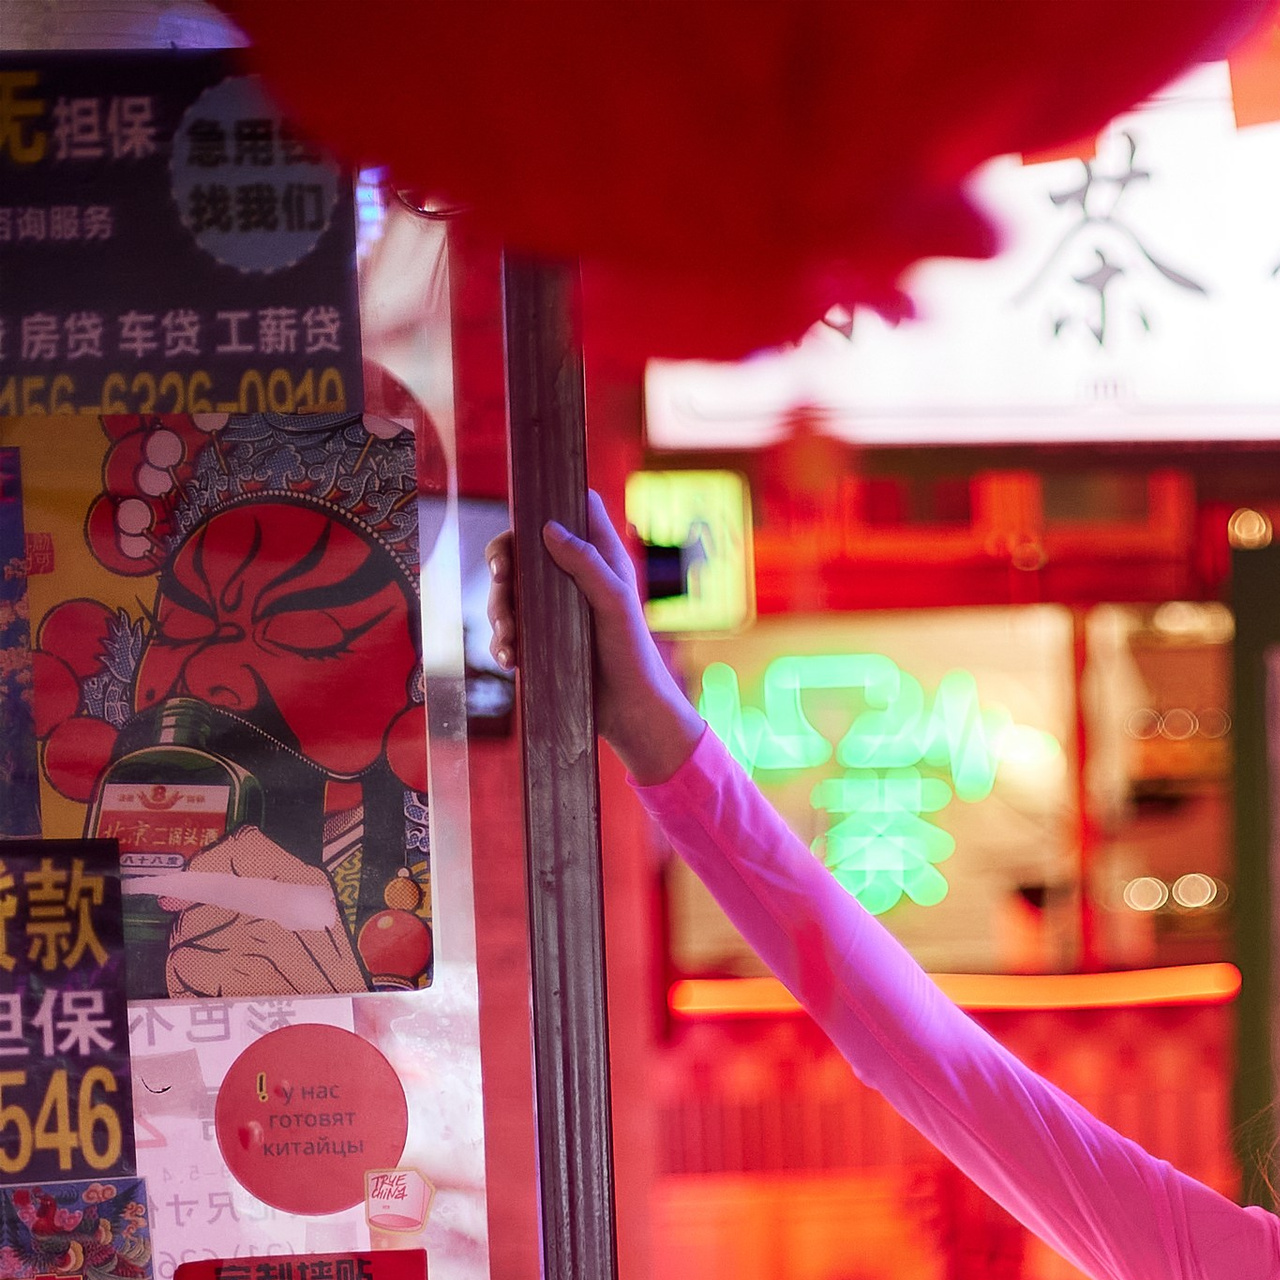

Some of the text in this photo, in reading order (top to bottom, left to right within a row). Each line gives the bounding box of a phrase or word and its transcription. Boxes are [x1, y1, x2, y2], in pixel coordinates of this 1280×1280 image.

[190, 182, 327, 233] 找我们
[21, 312, 103, 360] 房贷
[118, 309, 201, 358] 车贷
[215, 305, 342, 353] 工薪贷
[0, 857, 109, 973] 款
[301, 1084, 340, 1100] нас
[269, 1111, 357, 1129] готовят
[262, 1137, 364, 1157] китайцы
[371, 1174, 407, 1190] TRUE
